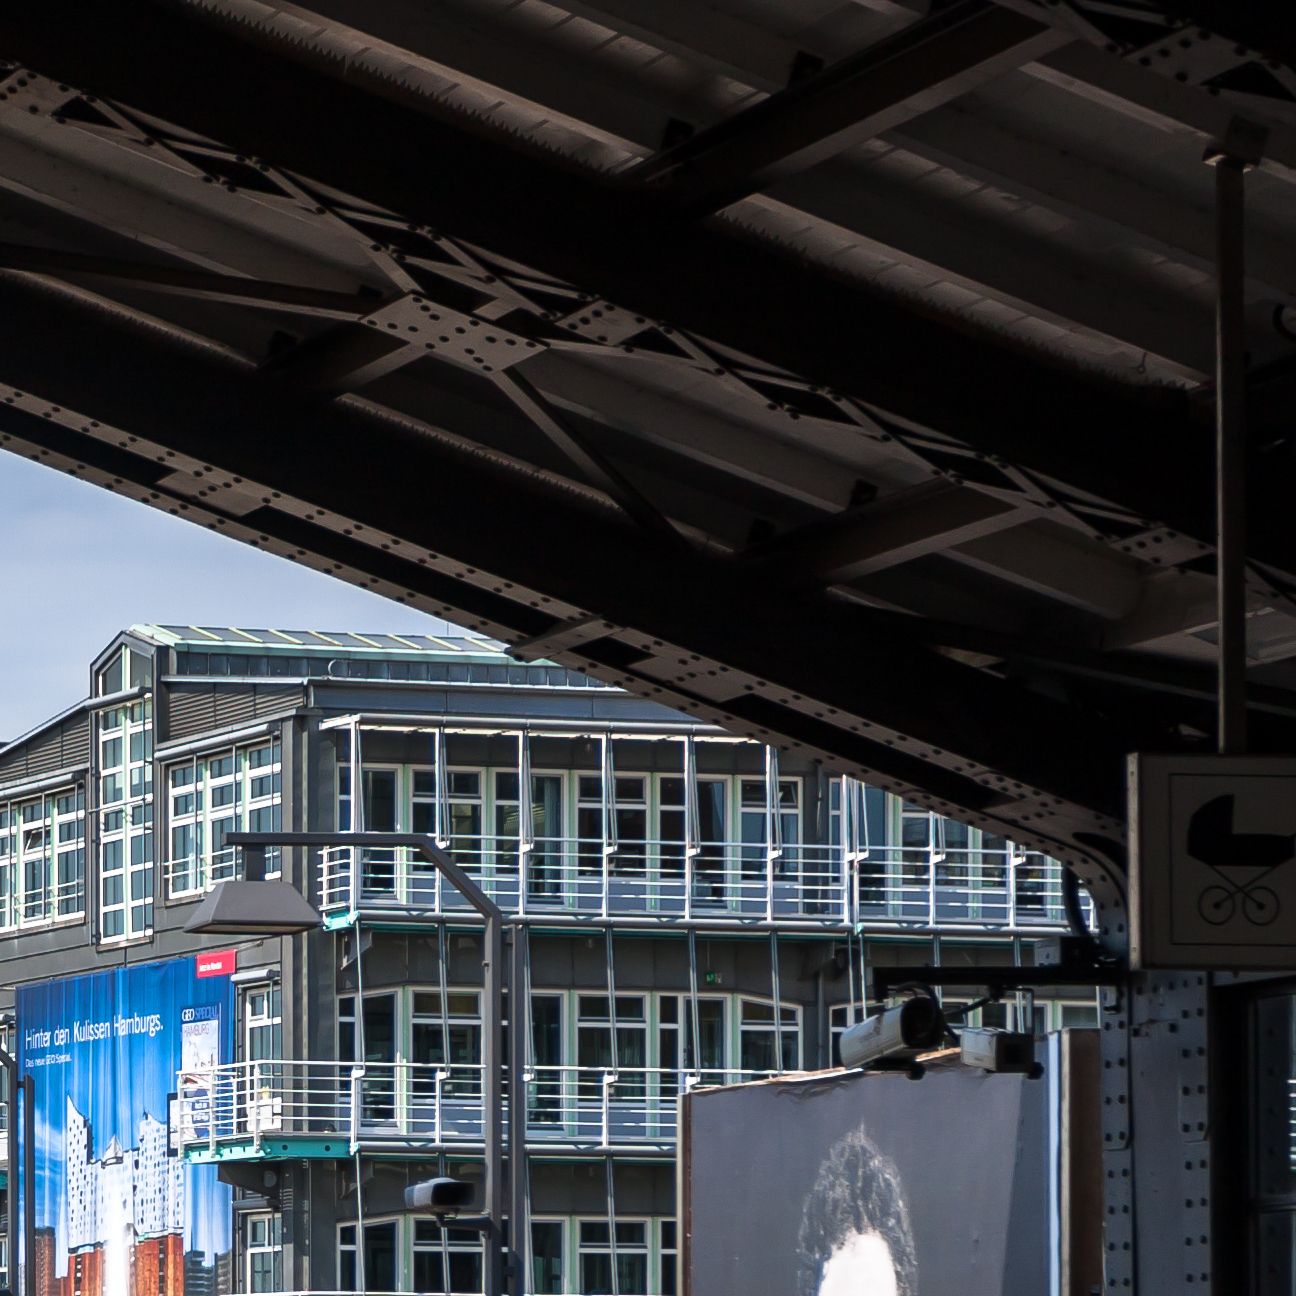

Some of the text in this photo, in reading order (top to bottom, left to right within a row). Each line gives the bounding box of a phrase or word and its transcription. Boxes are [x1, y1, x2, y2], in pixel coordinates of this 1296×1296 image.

[25, 1012, 164, 1050] Hinter den Kulissen Hamburgs.
